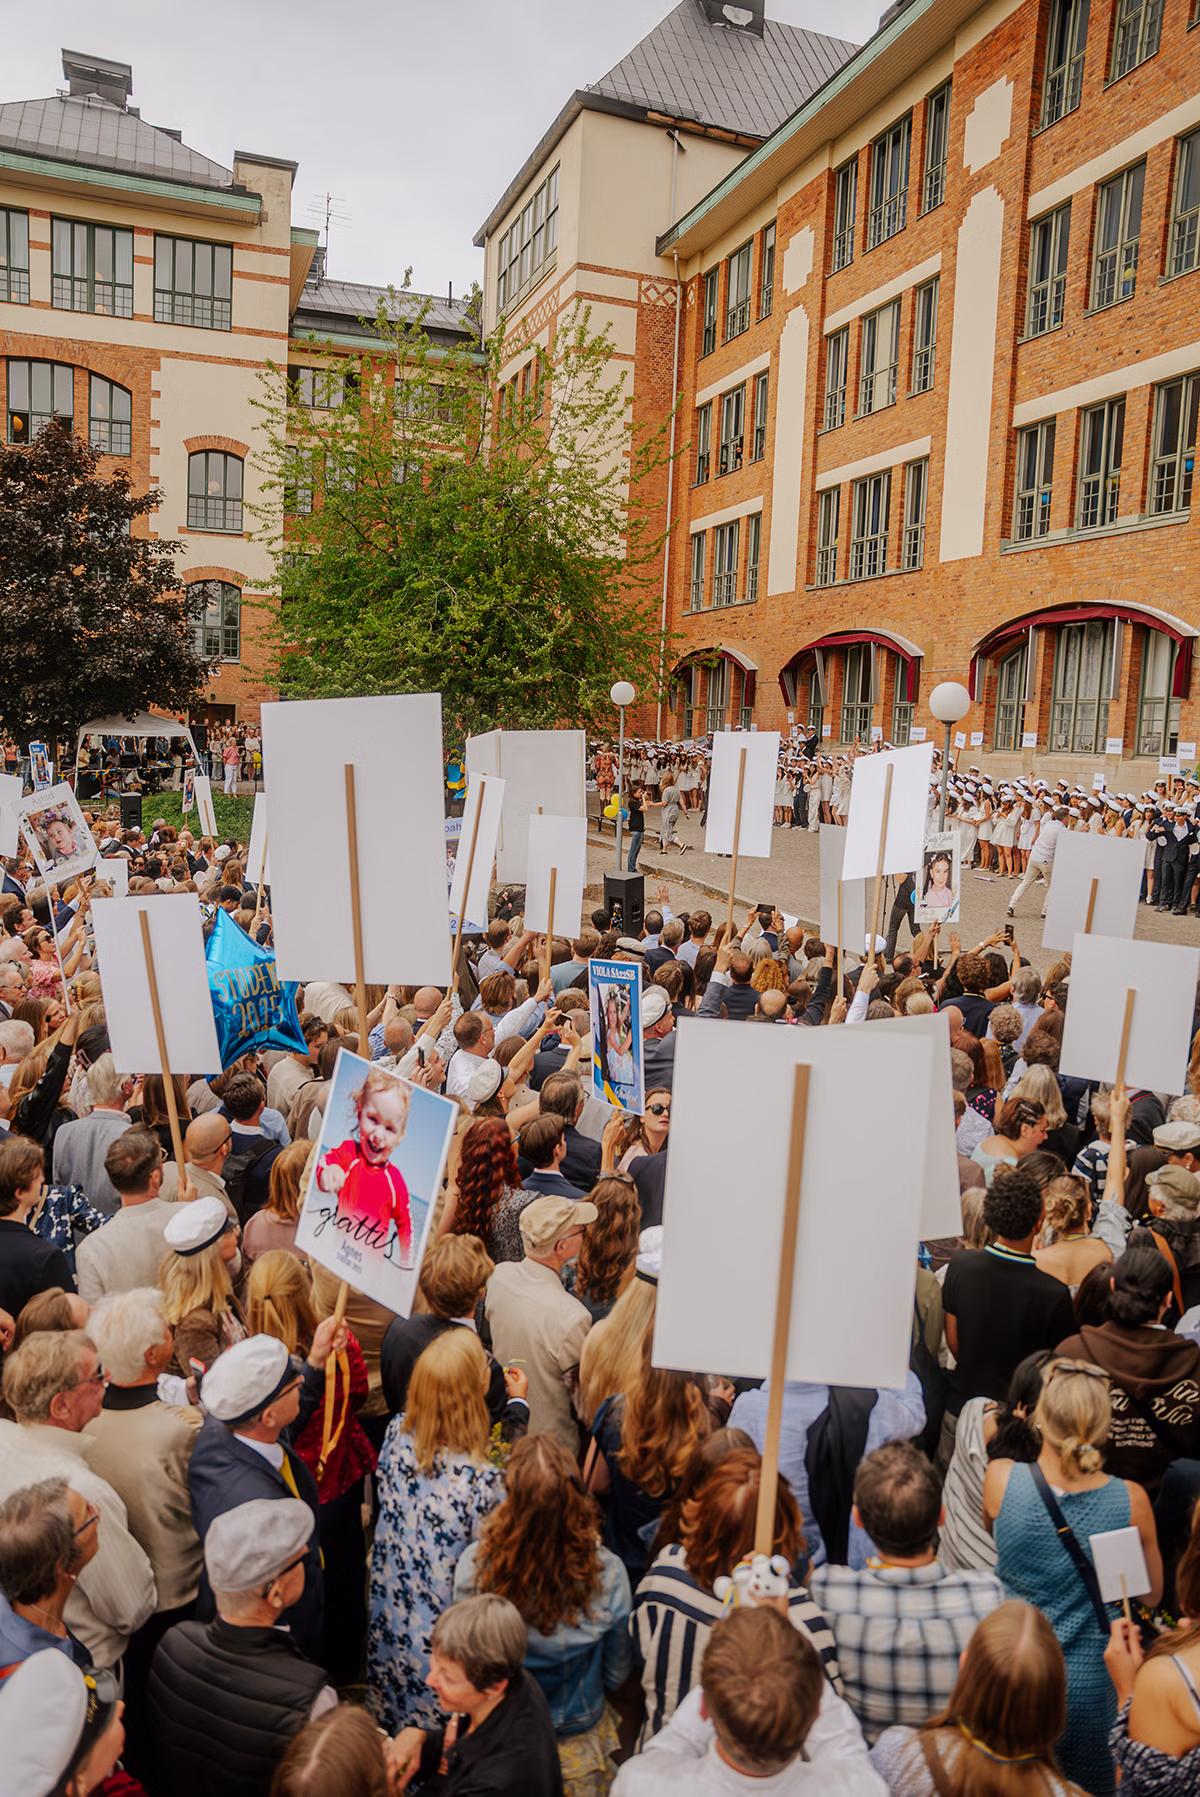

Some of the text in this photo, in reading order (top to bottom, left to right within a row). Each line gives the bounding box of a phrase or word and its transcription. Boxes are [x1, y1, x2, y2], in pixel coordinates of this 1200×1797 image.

[32, 791, 55, 805] Astrid
[445, 822, 462, 833] oah
[592, 965, 636, 981] VIOLA SA22SB
[231, 994, 284, 1039] 2025
[307, 1204, 414, 1271] grattis
[1115, 1439, 1154, 1448] SOMETHING
